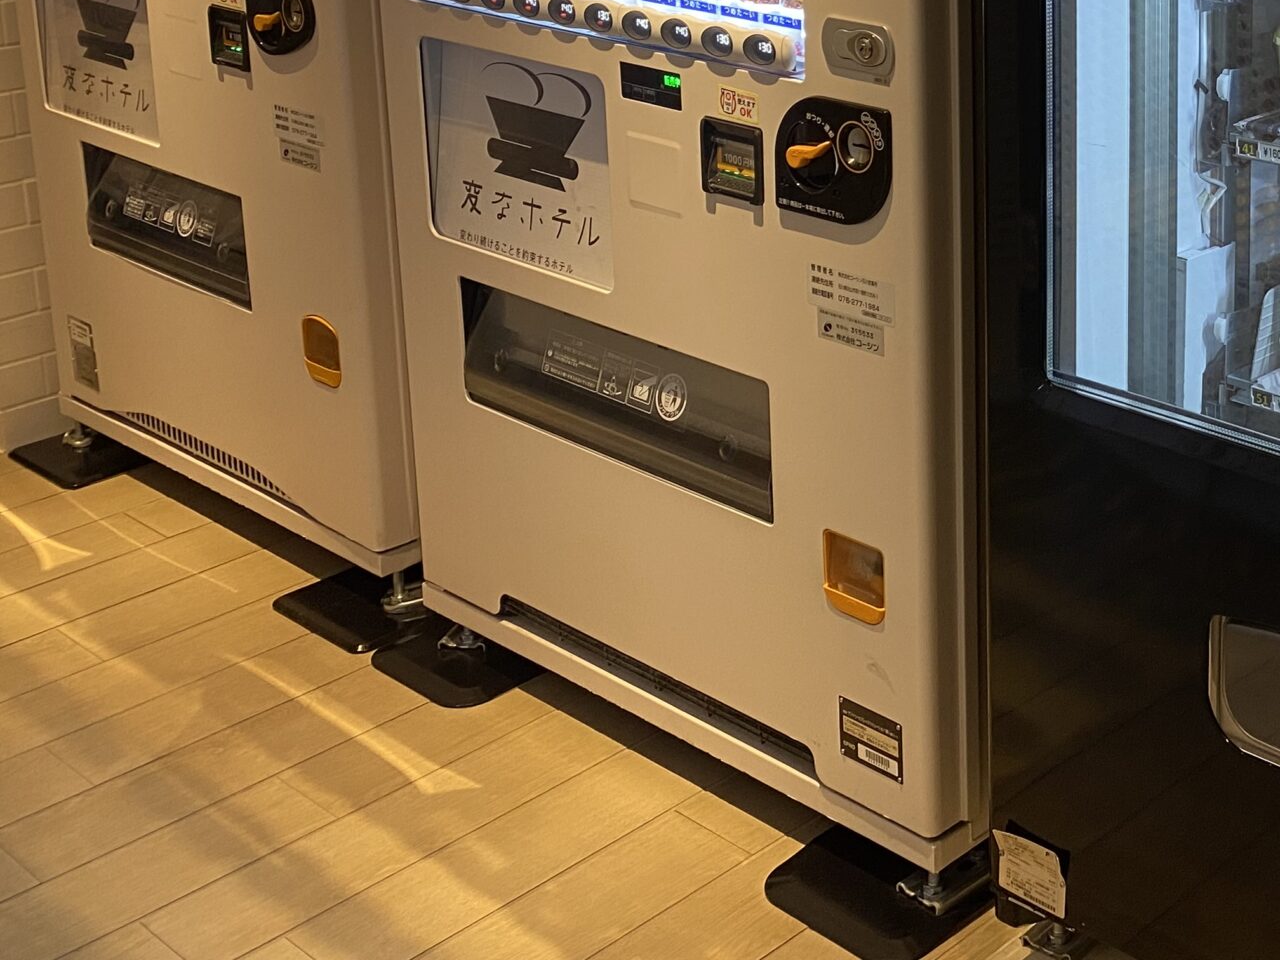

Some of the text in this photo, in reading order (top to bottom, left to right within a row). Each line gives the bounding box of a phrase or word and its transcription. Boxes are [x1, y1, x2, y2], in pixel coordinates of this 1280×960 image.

[63, 64, 150, 113] 変なホテル
[740, 107, 752, 118] OK
[461, 179, 600, 247] 変なホテル
